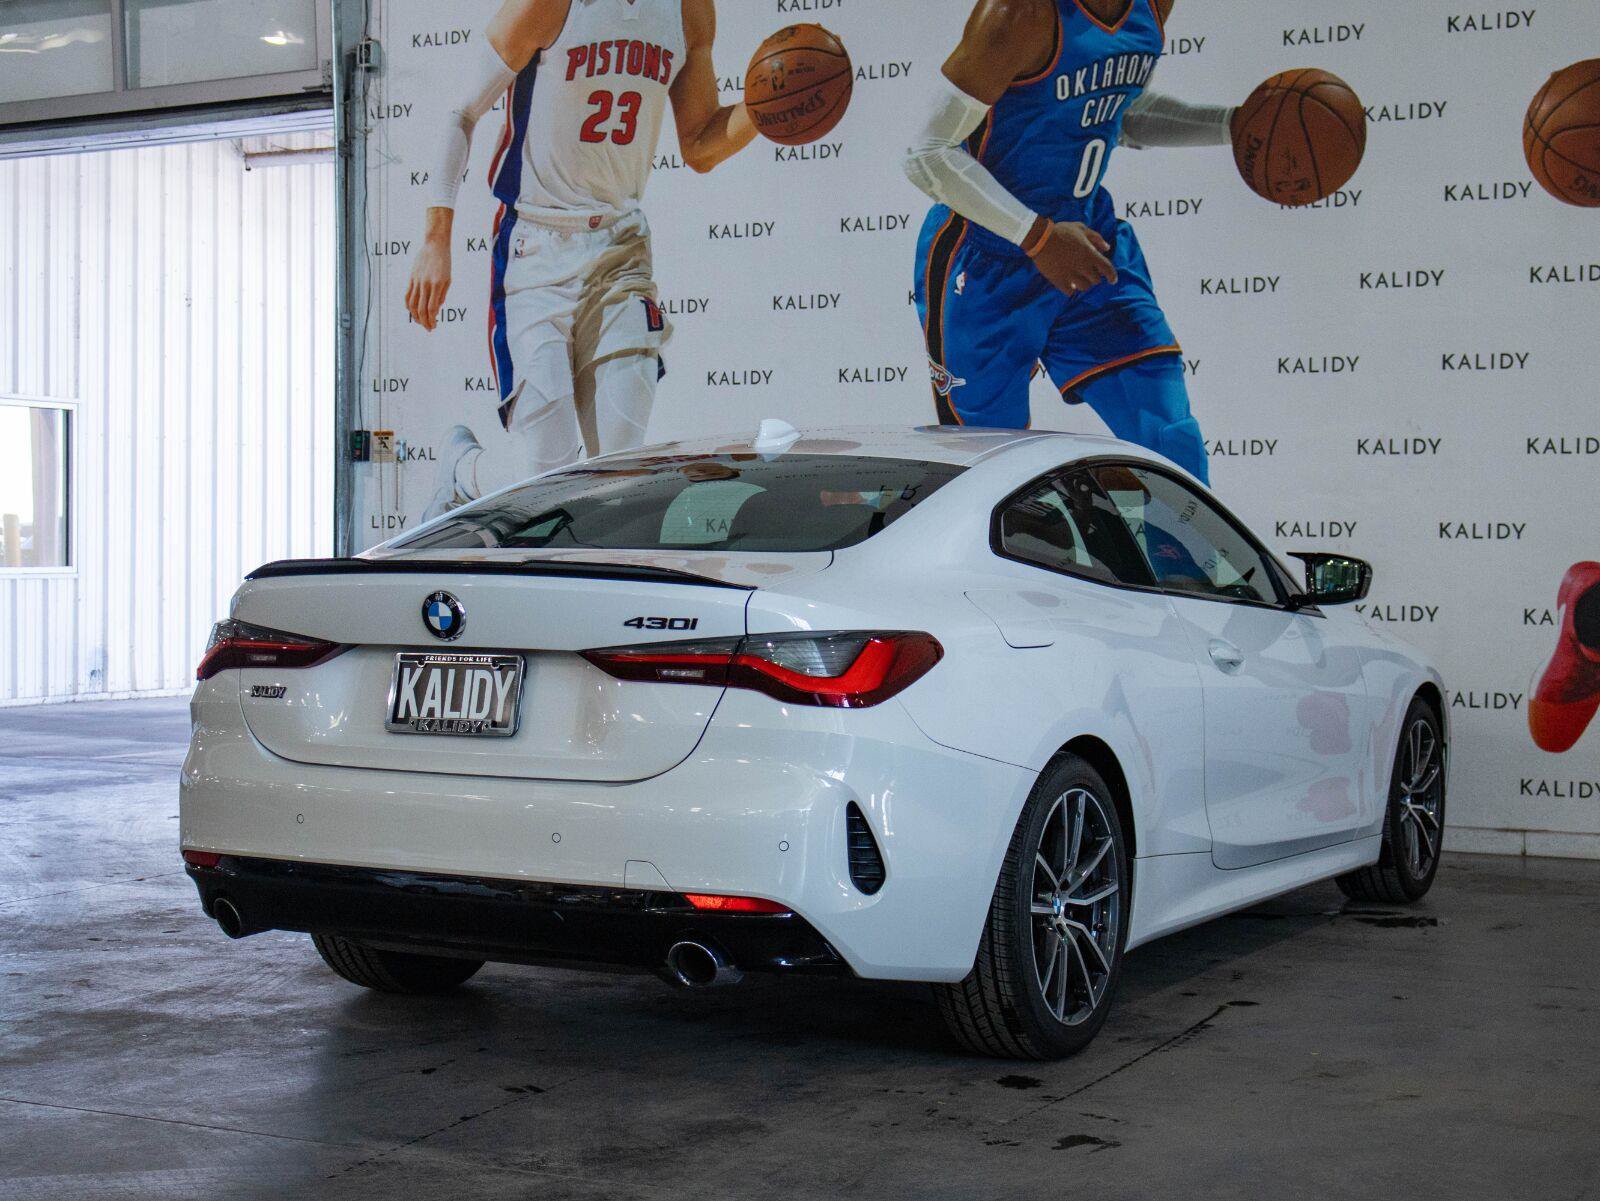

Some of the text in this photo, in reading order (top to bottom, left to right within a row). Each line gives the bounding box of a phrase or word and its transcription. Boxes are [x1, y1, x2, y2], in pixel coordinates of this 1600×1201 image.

[1447, 10, 1536, 32] KALIDY
[413, 29, 470, 47] KALIDY
[1284, 24, 1364, 46] KALIDY
[565, 39, 674, 85] PISTONS
[856, 62, 912, 80] ALIDY
[1056, 54, 1155, 100] OKLAHOM
[579, 89, 642, 146] 23
[1081, 94, 1126, 128] CITY
[1364, 101, 1447, 122] KALIDY
[774, 143, 843, 161] KALIDY
[1073, 138, 1106, 198] 0
[1445, 181, 1532, 201] KALIDY
[1126, 199, 1203, 218] KALIDY
[710, 222, 774, 239] KALIDY
[841, 215, 909, 232] KALIDY
[375, 241, 410, 256] LIDY
[1360, 270, 1444, 289] KALIDY
[1530, 265, 1600, 283] KALID
[1201, 276, 1279, 294] KALIDY
[657, 299, 709, 315] ALIDY
[774, 294, 840, 310] KALIDY
[1278, 356, 1359, 373] KALIDY
[1442, 353, 1529, 370] KALIDY
[708, 370, 772, 385] KALIDY
[839, 367, 907, 383] KALIDY
[374, 378, 408, 393] LIDY
[465, 378, 495, 391] KAL
[407, 447, 437, 461] KAL
[1358, 438, 1441, 455] KALIDY
[1527, 438, 1599, 454] KALID
[372, 516, 406, 528] LIDY
[1276, 522, 1356, 537] KALIDY
[1440, 523, 1525, 539] KALIDY
[398, 667, 516, 723] KALIDY
[1452, 692, 1522, 709] ALIDY
[417, 719, 483, 733] KALIDY
